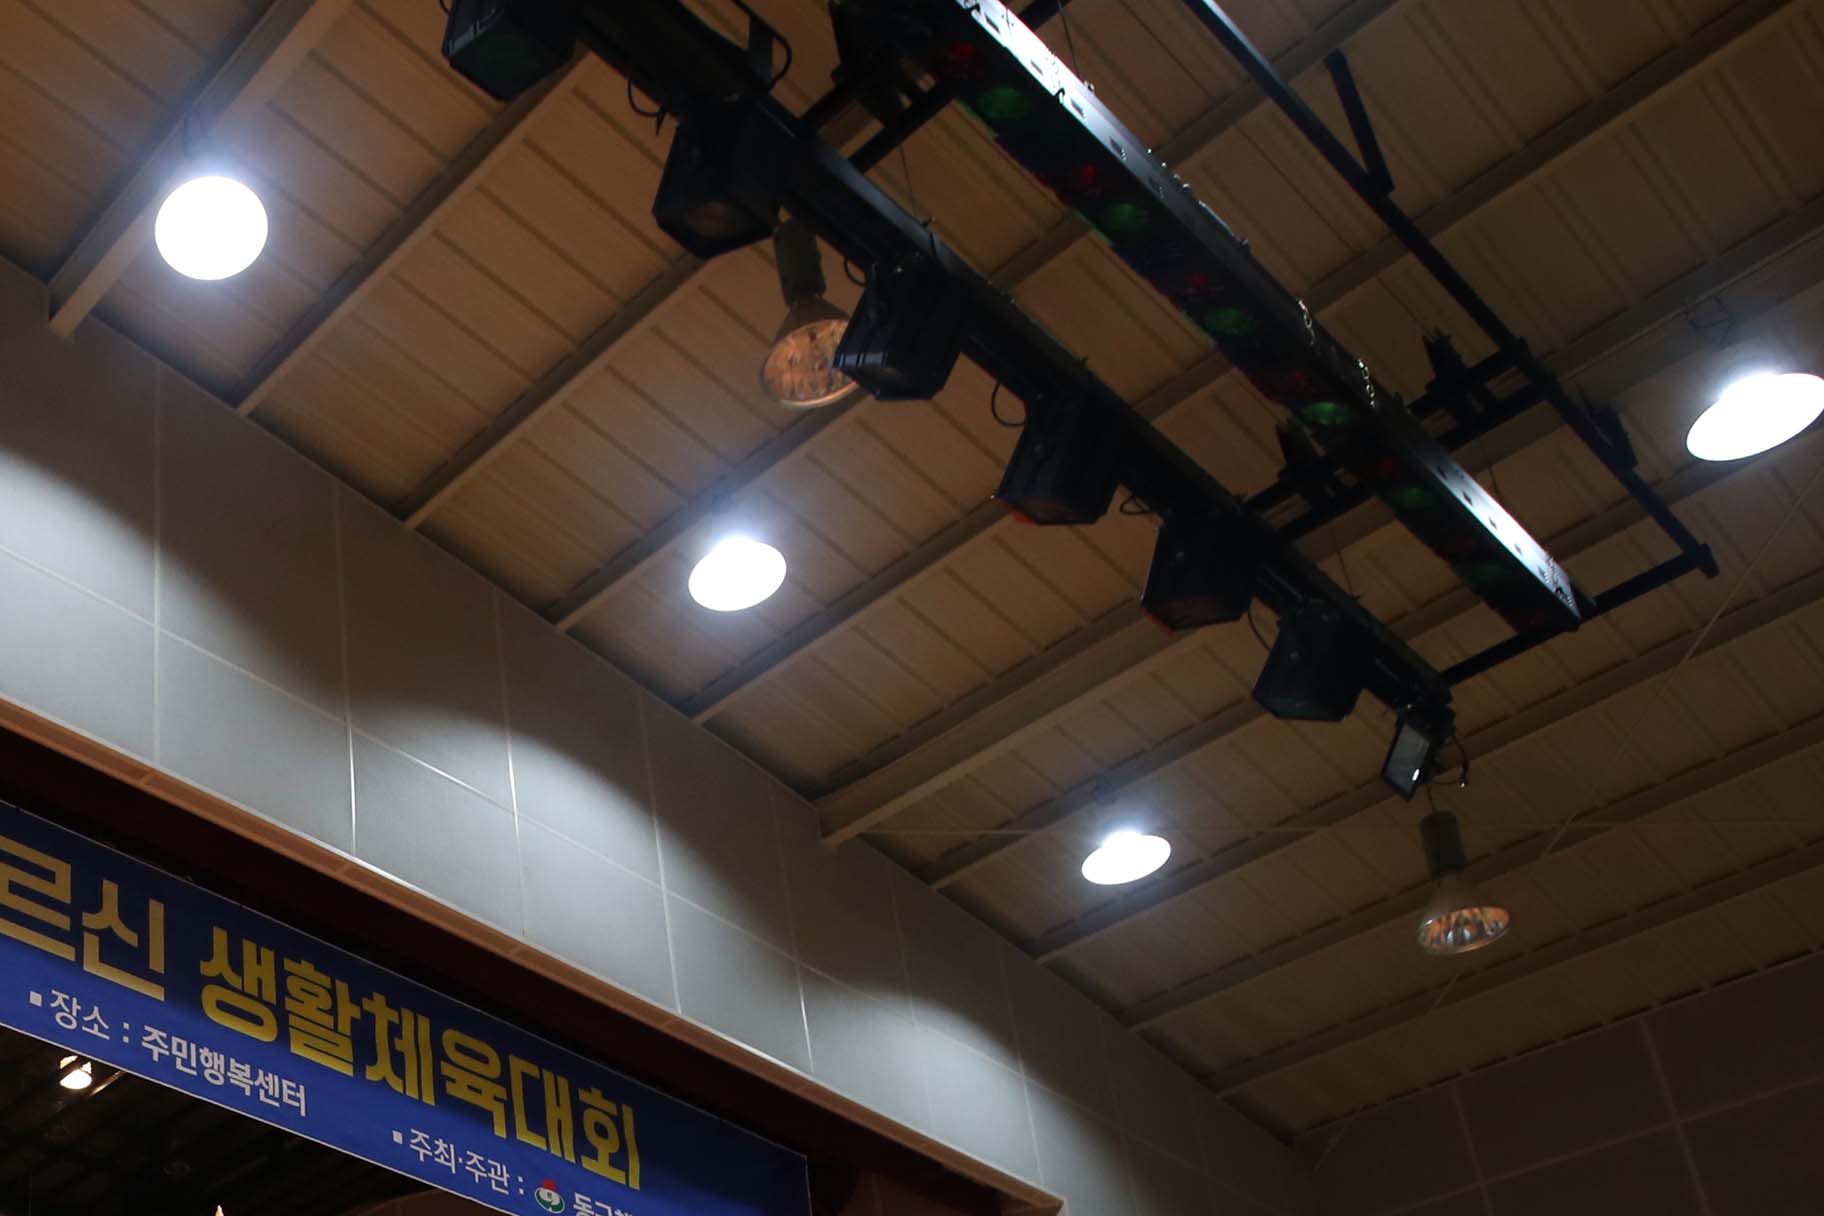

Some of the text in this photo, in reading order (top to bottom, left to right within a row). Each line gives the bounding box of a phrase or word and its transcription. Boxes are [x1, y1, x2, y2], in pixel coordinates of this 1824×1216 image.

[49, 989, 111, 1040] 장소
[141, 1024, 307, 1117] 주민행복센터
[199, 926, 641, 1190] 생활체육대회
